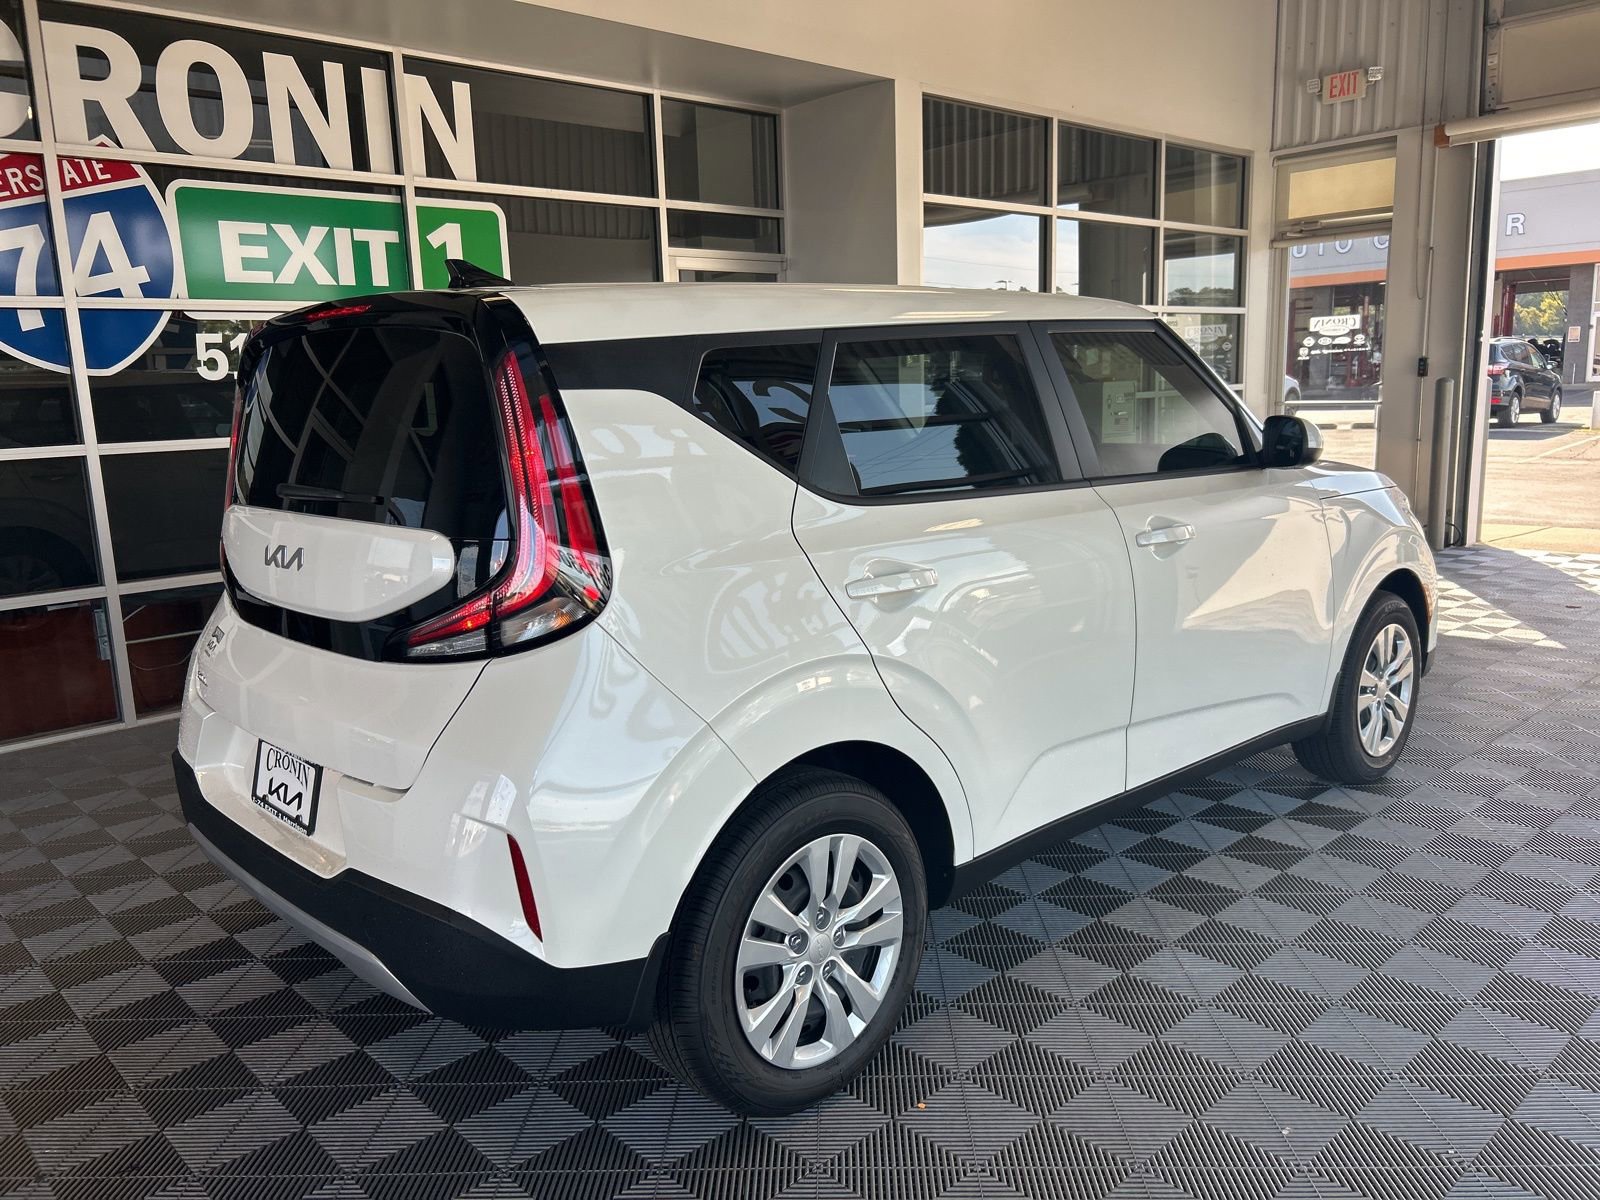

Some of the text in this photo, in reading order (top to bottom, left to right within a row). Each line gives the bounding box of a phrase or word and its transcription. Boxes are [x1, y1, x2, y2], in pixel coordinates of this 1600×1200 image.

[1329, 71, 1360, 99] EXIT
[0, 211, 151, 332] 74
[217, 220, 464, 291] EXIT 1
[264, 544, 304, 571] KIA
[266, 747, 310, 791] CRONIN
[268, 776, 303, 811] KIA
